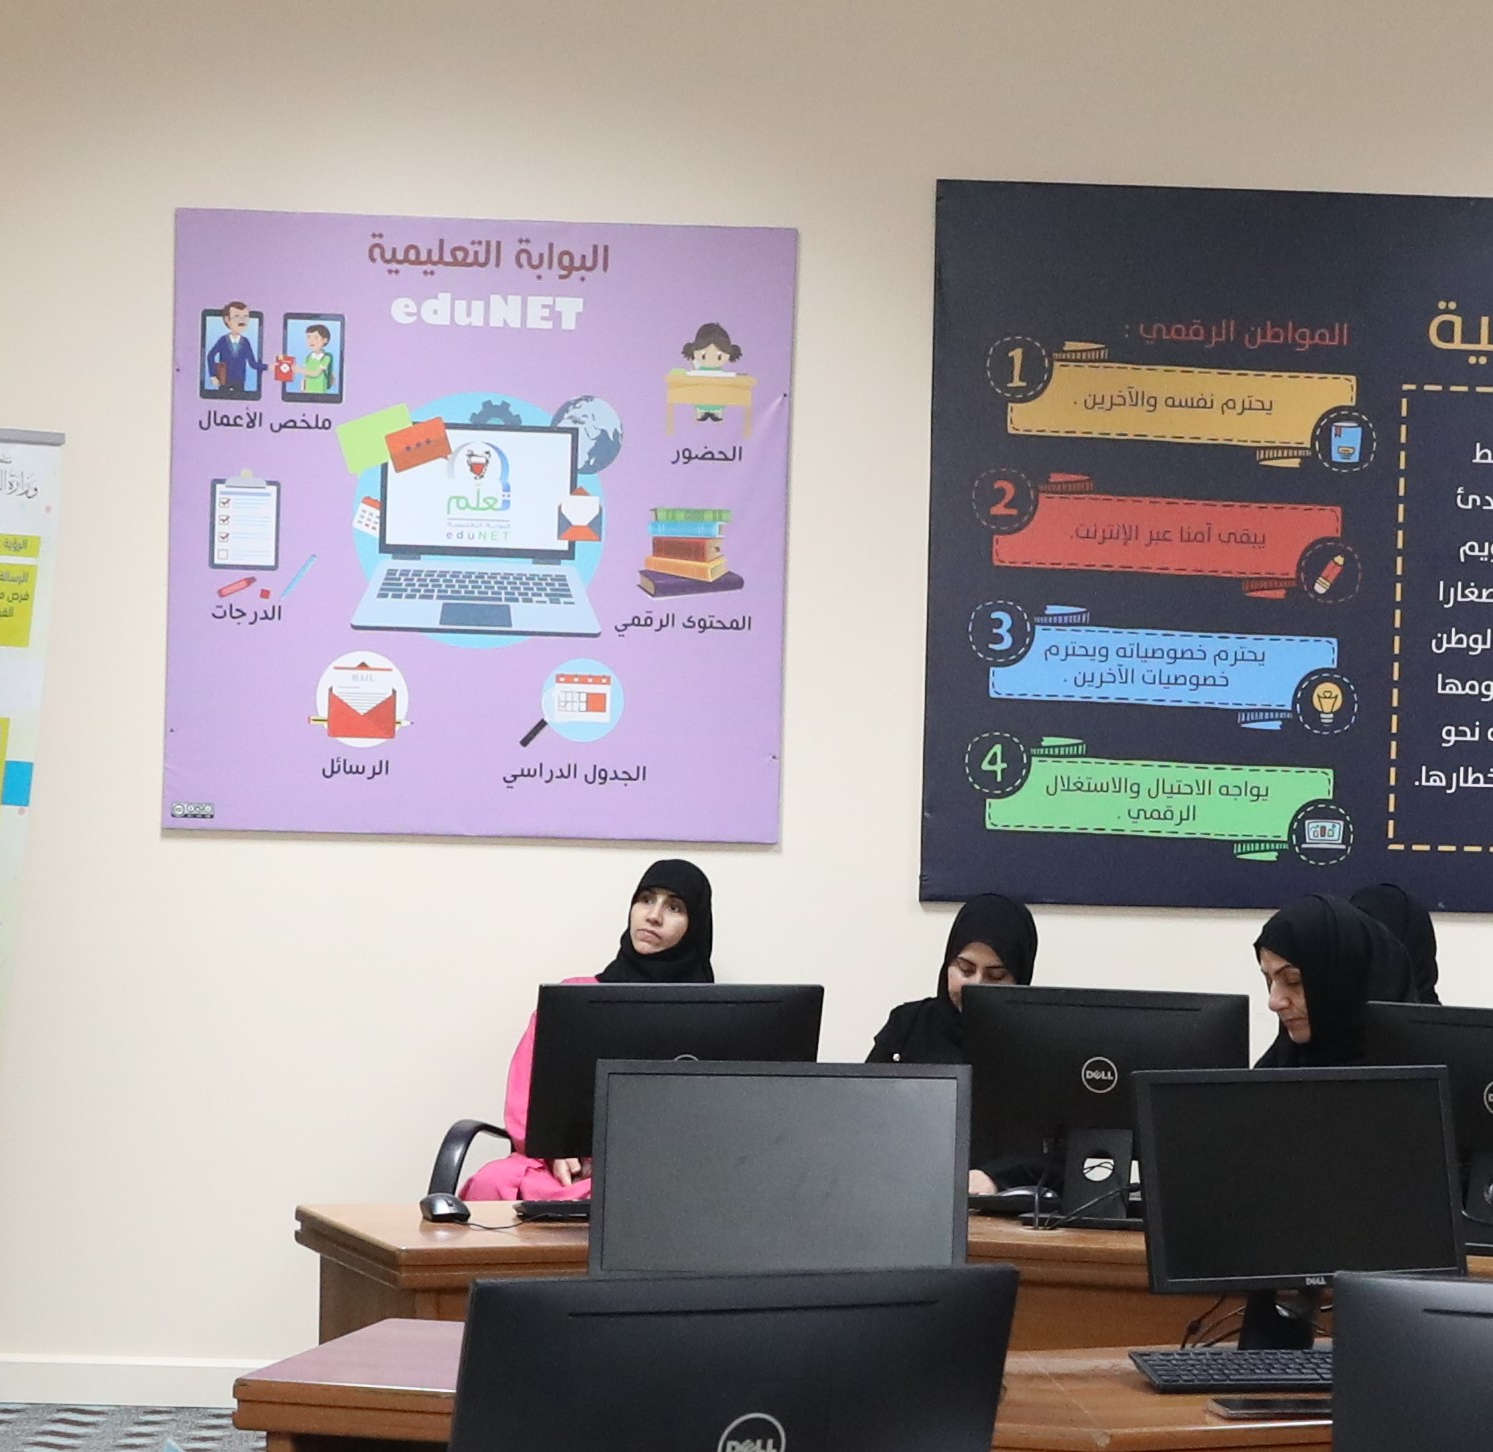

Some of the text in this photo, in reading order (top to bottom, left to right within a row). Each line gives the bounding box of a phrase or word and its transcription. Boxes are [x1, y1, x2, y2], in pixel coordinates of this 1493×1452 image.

[368, 233, 609, 282] البوابة التعليمية
[391, 292, 585, 329] eduNET
[1140, 319, 1349, 351] المواطن الرقمي
[1007, 348, 1026, 387] 1
[1084, 387, 1273, 416] يحترم نفسه والآخرين
[198, 406, 332, 437] ملخص الأعمال
[671, 444, 743, 467] الحضور
[990, 480, 1018, 516] 2
[1145, 530, 1172, 547] عبر
[1179, 526, 1211, 544] آمنا
[1218, 529, 1265, 548] يبقى
[212, 604, 281, 625] الدرجات
[615, 611, 751, 637] المحتوى الرقمي
[989, 611, 1013, 650] 3
[1043, 641, 1266, 667] يحترم خصوصياته ويحترم
[1074, 664, 1228, 691] خصوصيات الآخرين
[1442, 721, 1479, 747] نحو
[322, 757, 389, 780] الرسائل
[503, 763, 646, 788] الجدول الدراسي
[981, 744, 1007, 782] 4
[1046, 775, 1268, 802] يواجه الاحتيال والاستغلال
[1128, 805, 1195, 826] الرقمي
[1086, 1070, 1113, 1080] DELL
[1306, 1277, 1326, 1285] DELL
